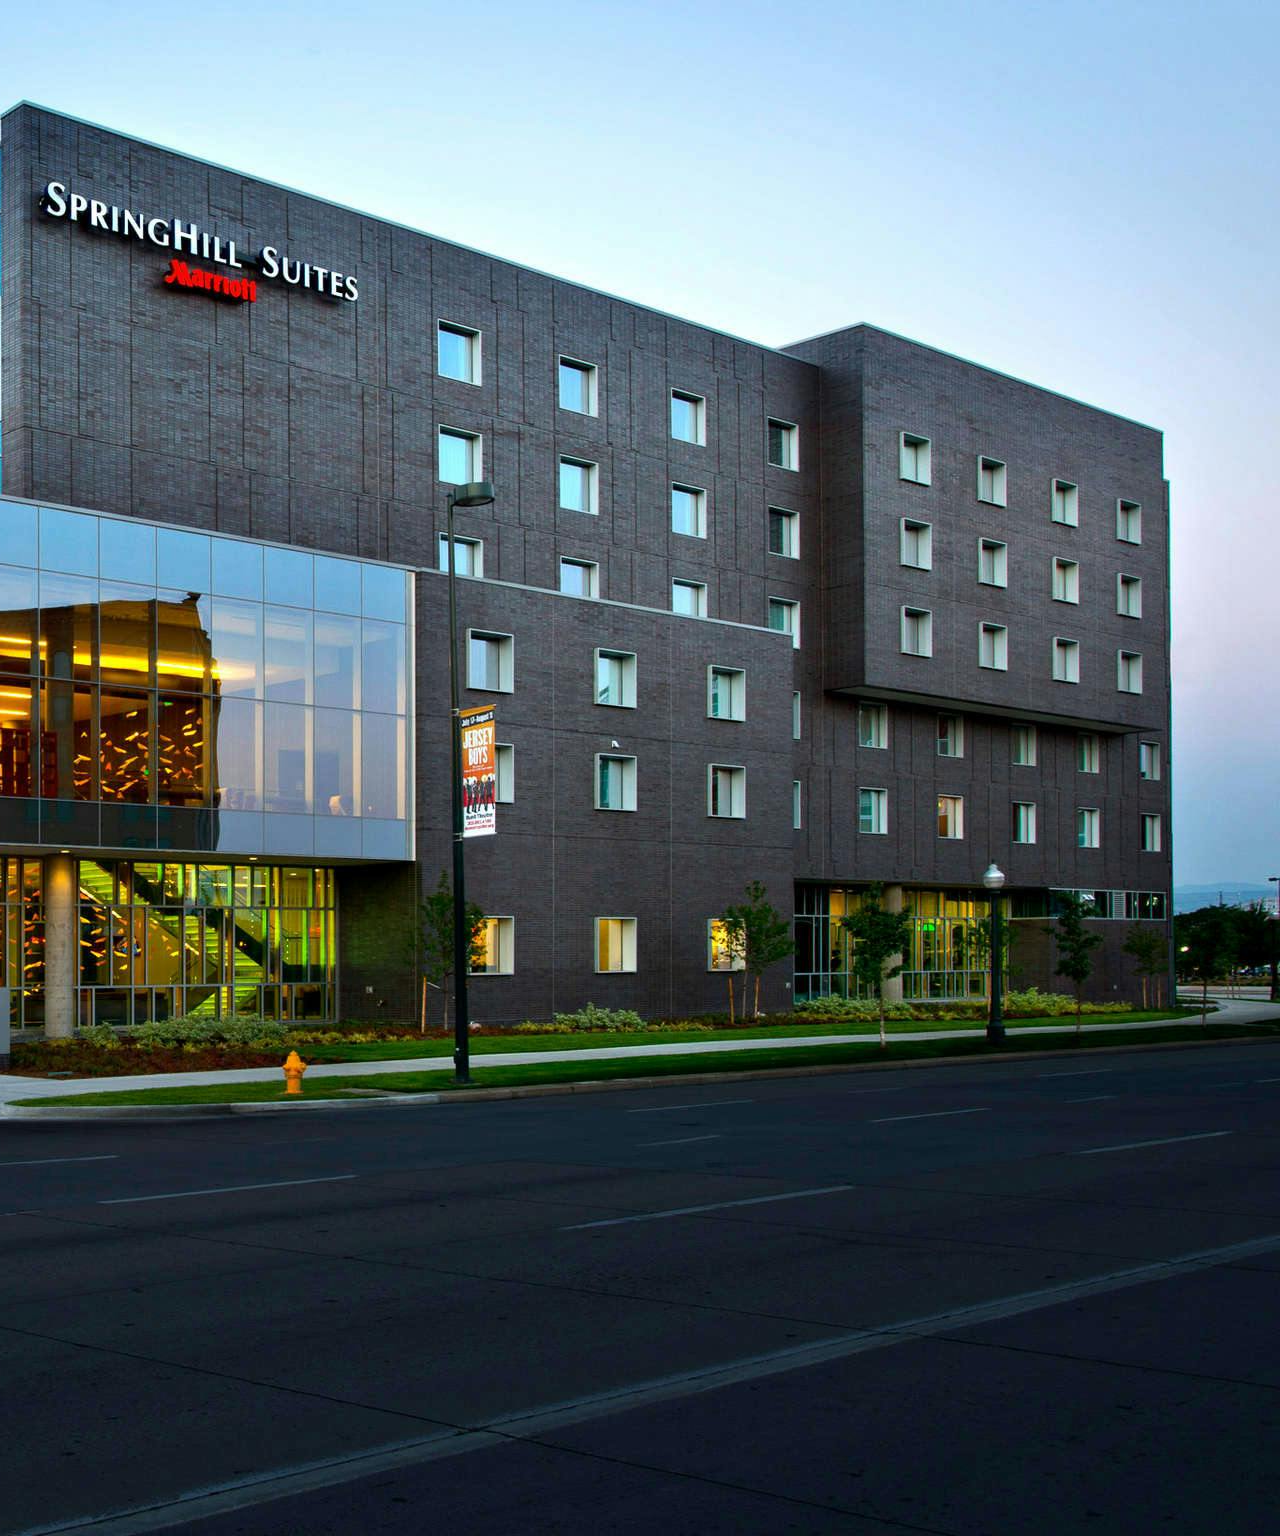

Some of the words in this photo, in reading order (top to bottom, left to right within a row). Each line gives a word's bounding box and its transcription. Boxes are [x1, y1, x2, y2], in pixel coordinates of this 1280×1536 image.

[46, 181, 242, 268] SPRINGHILL
[261, 246, 359, 301] SUITES
[164, 258, 256, 302] Marriott
[463, 728, 492, 749] JERSEY
[468, 746, 488, 766] BOYS
